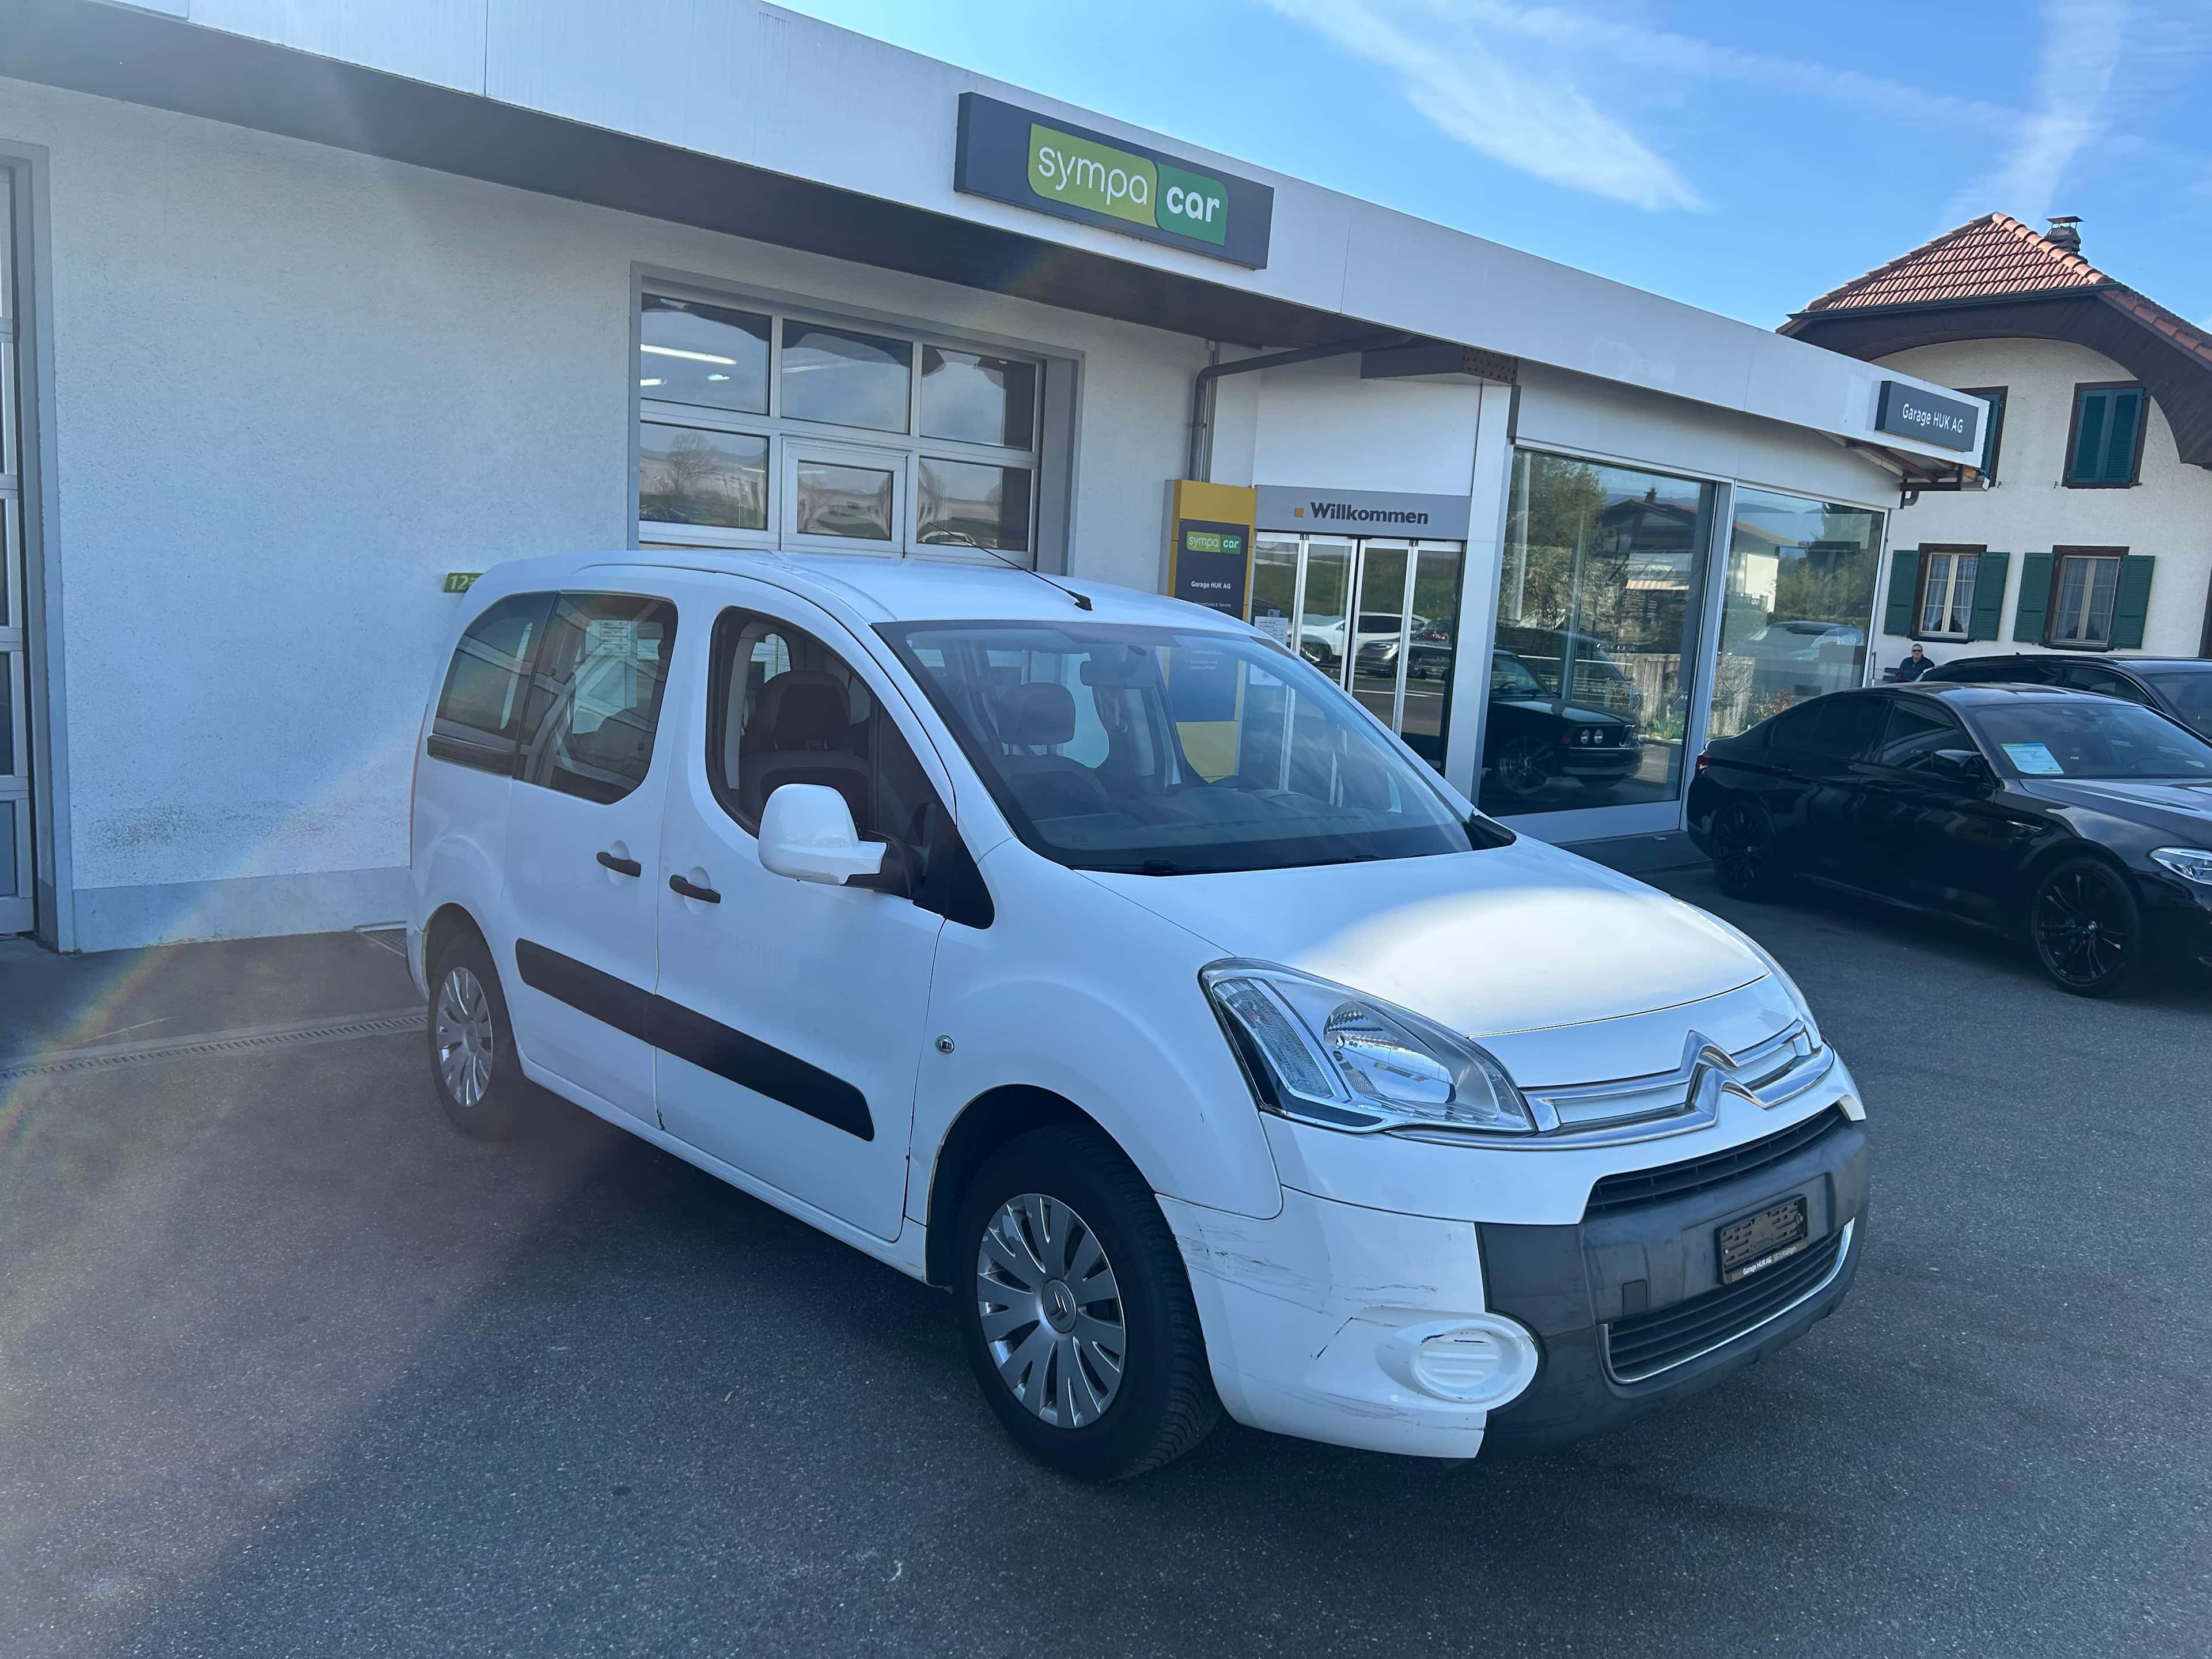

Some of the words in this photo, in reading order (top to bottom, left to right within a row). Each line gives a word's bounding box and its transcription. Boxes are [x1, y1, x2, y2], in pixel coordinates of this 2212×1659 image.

[1038, 147, 1148, 205] sympa
[1166, 186, 1220, 223] car
[1902, 403, 1931, 427] Garage
[1933, 411, 1950, 430] HUK
[1950, 417, 1964, 433] AG
[1309, 502, 1429, 525] Willkommen
[1188, 536, 1219, 549] sympa
[1222, 539, 1240, 549] car
[1191, 580, 1210, 589] Garage
